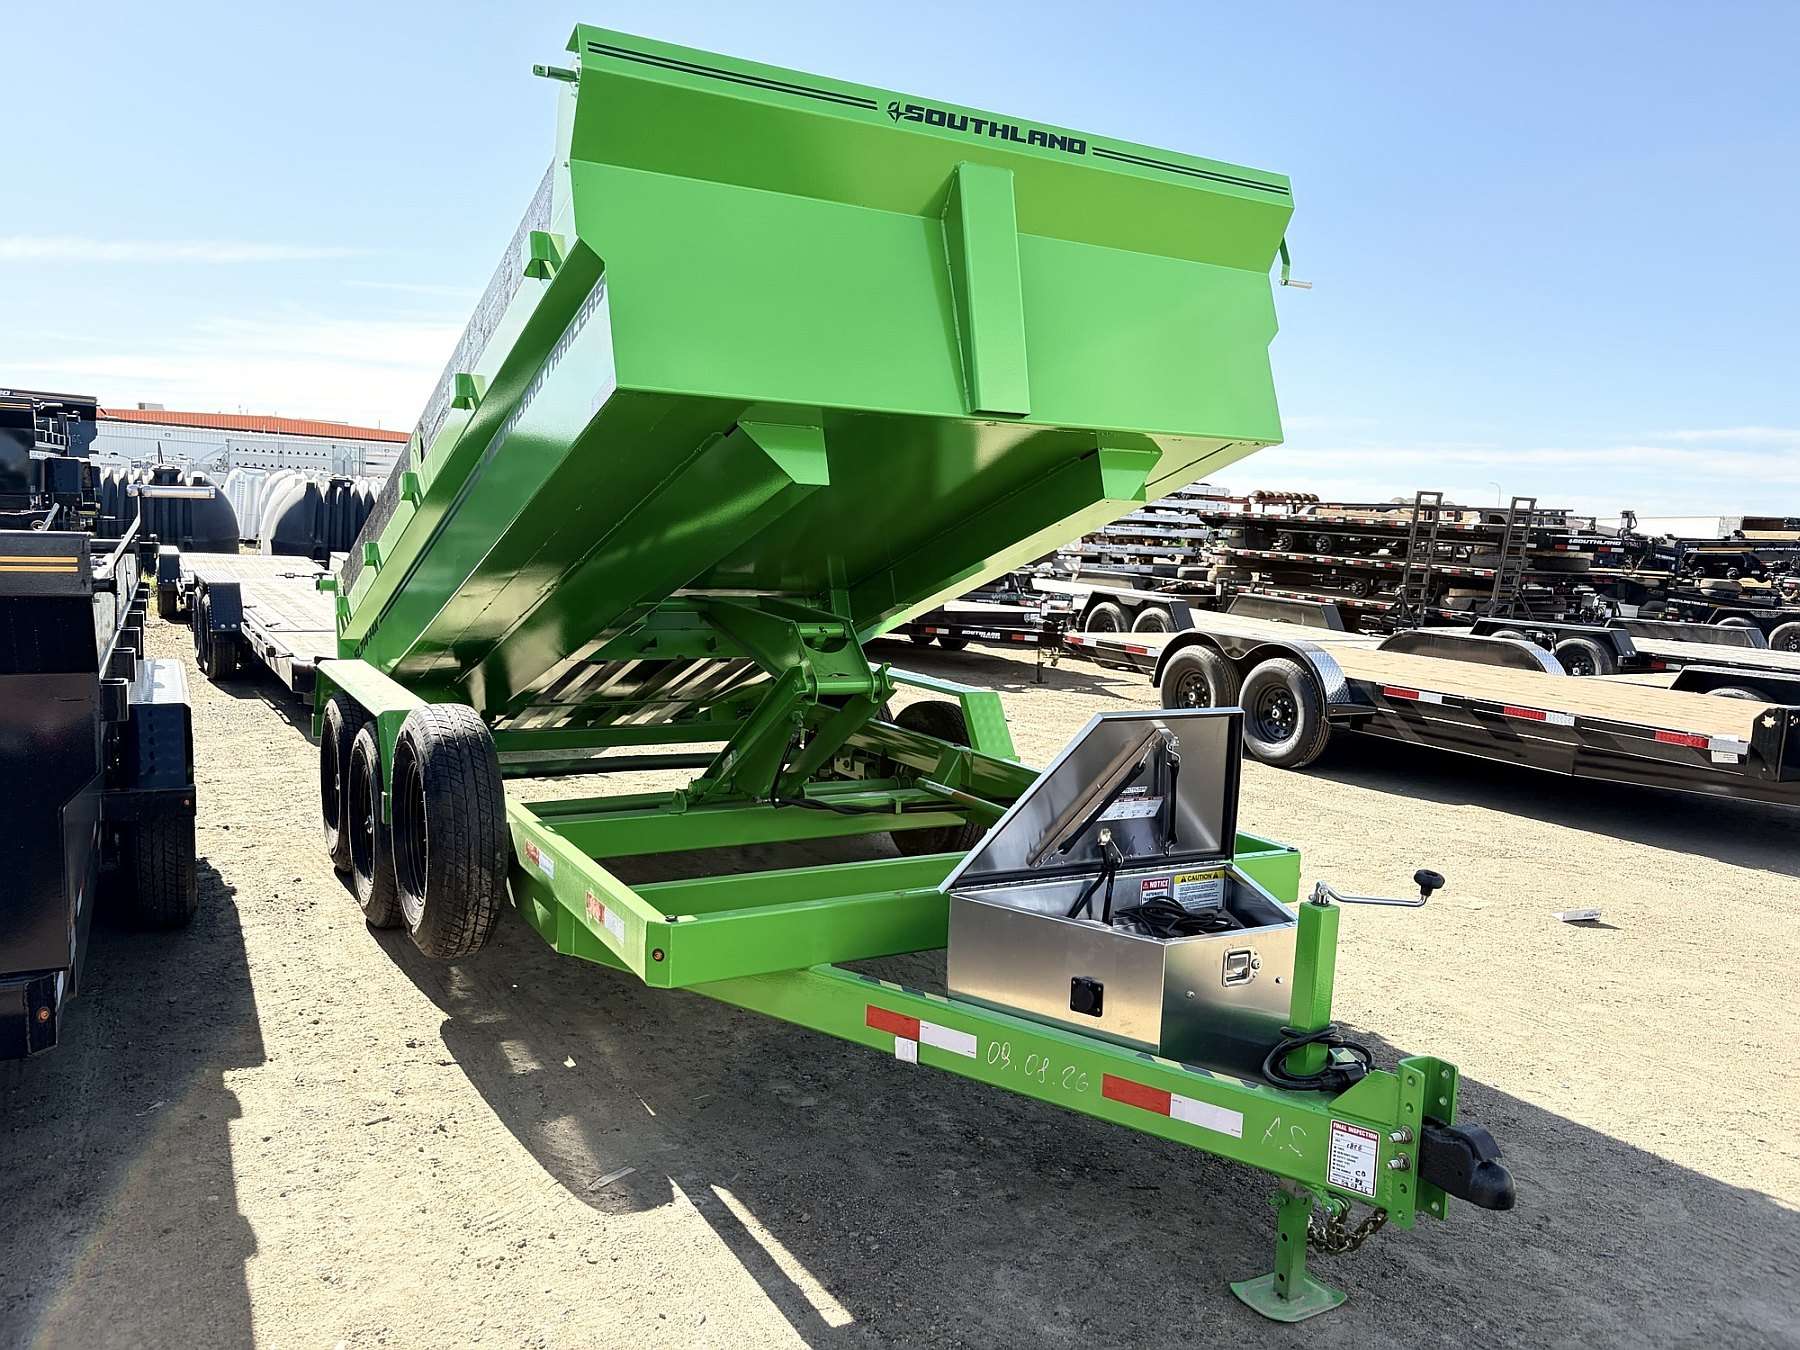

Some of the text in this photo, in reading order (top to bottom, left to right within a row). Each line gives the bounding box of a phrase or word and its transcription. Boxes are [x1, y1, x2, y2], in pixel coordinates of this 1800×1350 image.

[904, 104, 1086, 154] SOUTHLAND
[1571, 538, 1622, 546] SOUTHLAND
[962, 629, 1000, 637] SOUTHLAND
[1187, 872, 1211, 882] CAUTION
[1149, 880, 1169, 889] NOTICE
[1333, 1122, 1348, 1132] FINAL
[1348, 1126, 1378, 1140] INSPECTION
